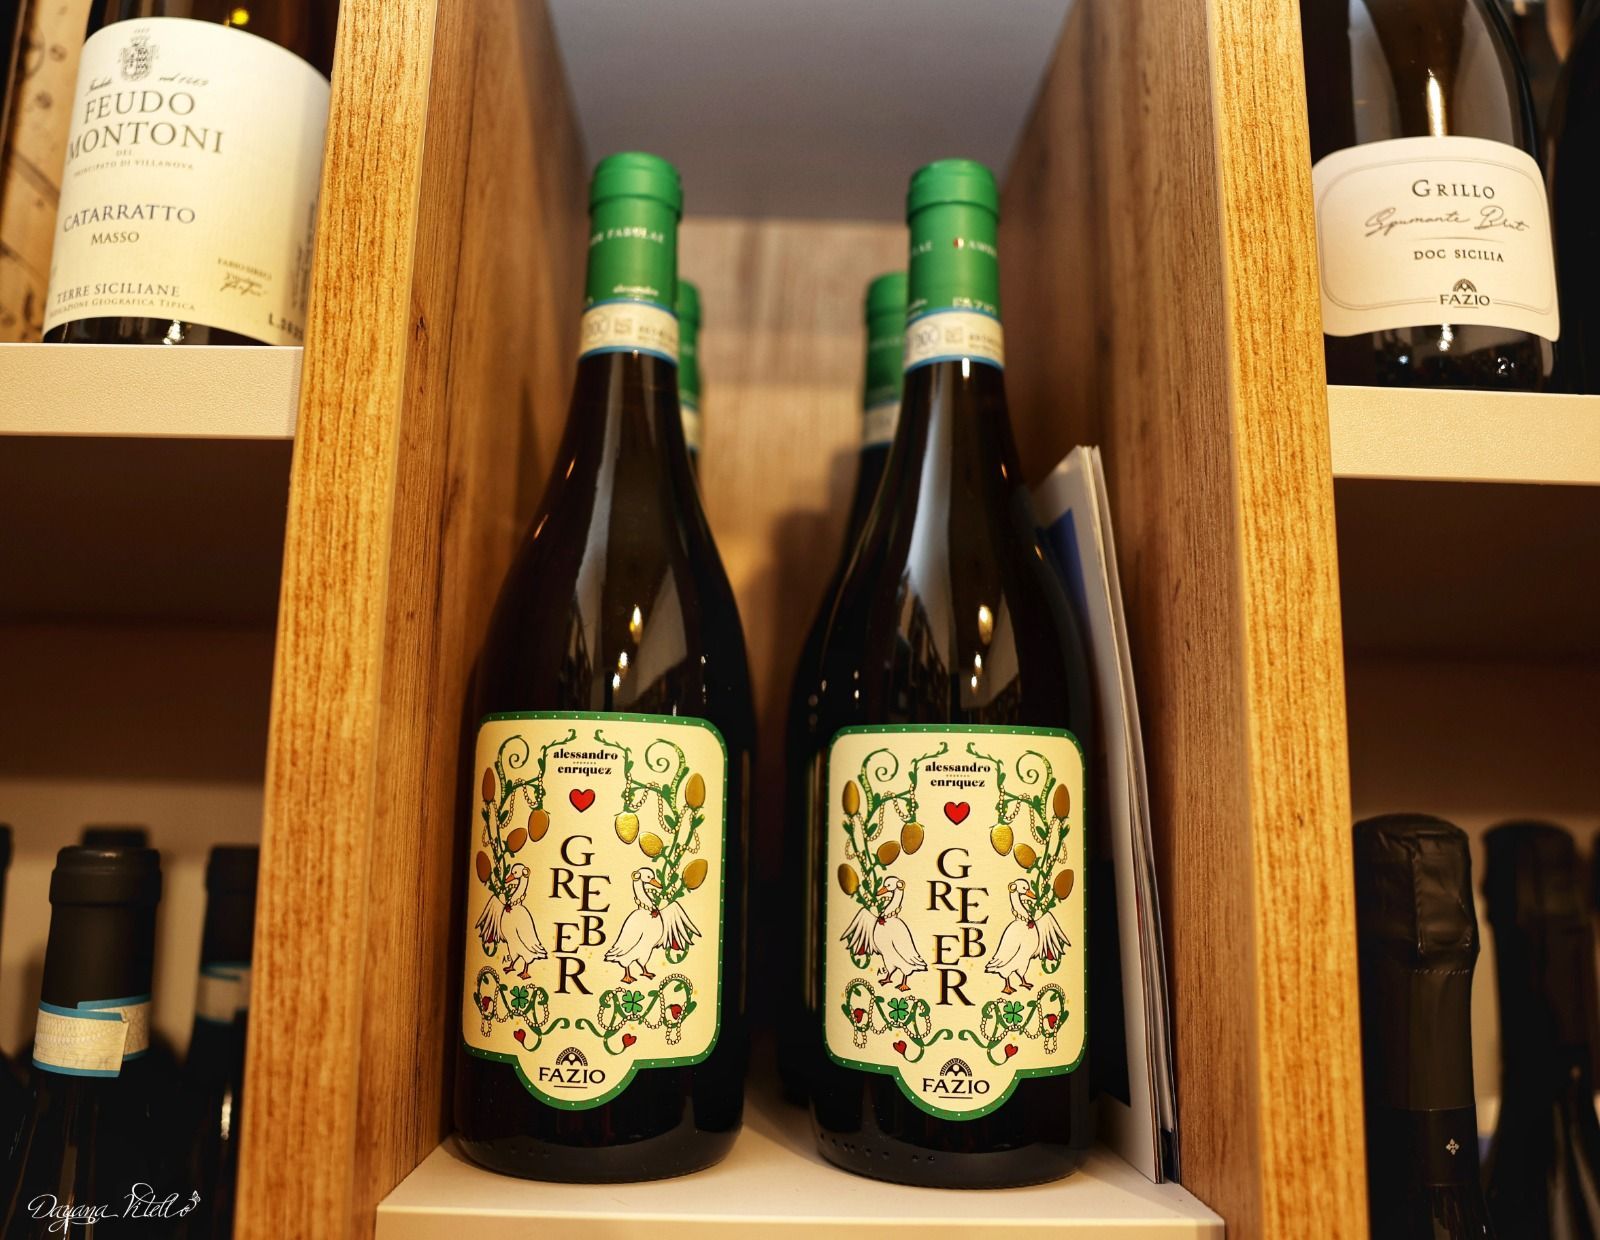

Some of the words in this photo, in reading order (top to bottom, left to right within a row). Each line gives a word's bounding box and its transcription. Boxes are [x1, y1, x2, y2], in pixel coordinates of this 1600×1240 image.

[84, 90, 195, 124] FEUDO
[69, 122, 223, 160] MONTONI
[1412, 179, 1495, 199] GRILLO
[63, 204, 196, 232] CATARRATTO
[1364, 207, 1470, 237] Spumante
[1474, 205, 1530, 231] Brut
[91, 231, 140, 245] MASSO
[1414, 249, 1446, 260] DOC
[1455, 249, 1504, 262] SICILIA
[57, 285, 89, 304] TERRE
[94, 282, 180, 297] SICILIANE
[1440, 294, 1490, 306] FAZIO
[91, 298, 154, 307] GEOGRAFICA
[159, 299, 196, 311] TIPICA
[552, 748, 619, 762] alessandro
[557, 764, 612, 776] enriquez
[924, 761, 991, 773] alessandro
[930, 776, 985, 788] enriquez
[539, 1066, 606, 1085] FAZIO
[922, 1077, 990, 1094] FAZIO
